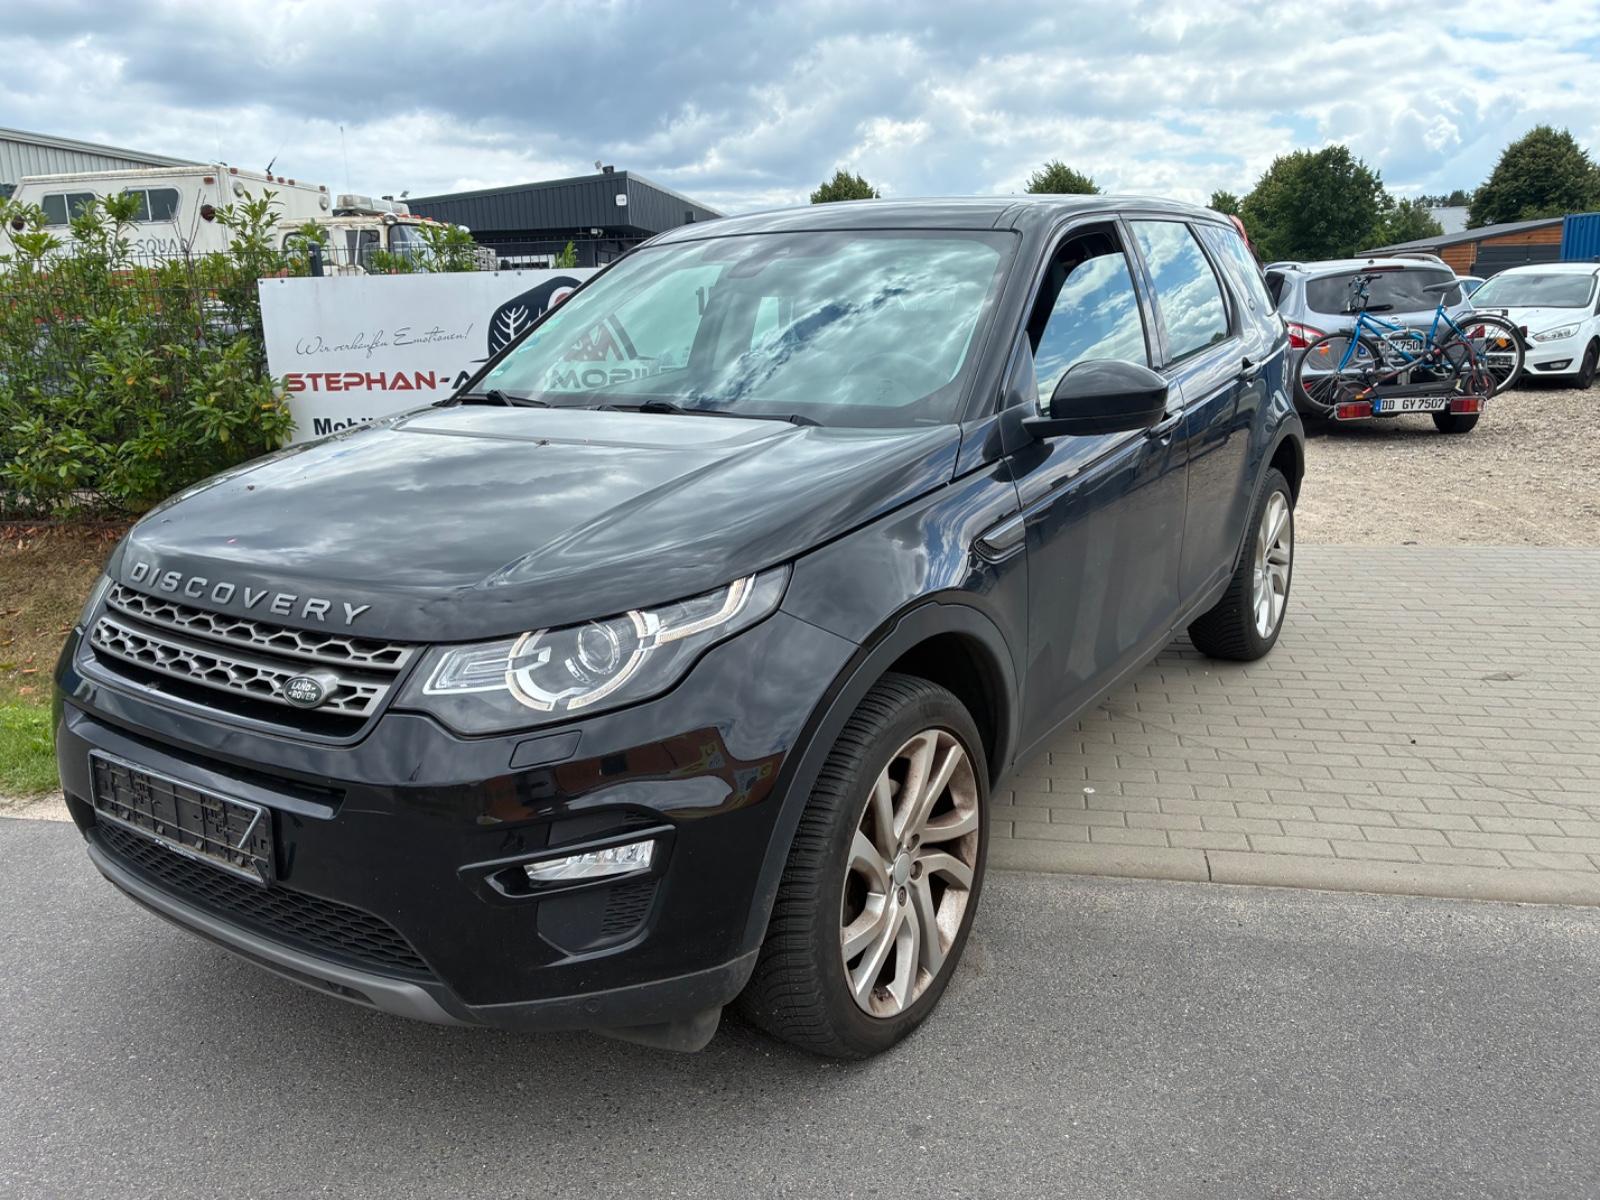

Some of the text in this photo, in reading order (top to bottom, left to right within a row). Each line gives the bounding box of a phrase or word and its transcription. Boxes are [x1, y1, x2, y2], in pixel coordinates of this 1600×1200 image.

[296, 336, 331, 355] Wir
[393, 323, 475, 346] Emotionen!
[1381, 398, 1445, 410] DD GY 7507
[130, 562, 371, 625] DISCOVERY
